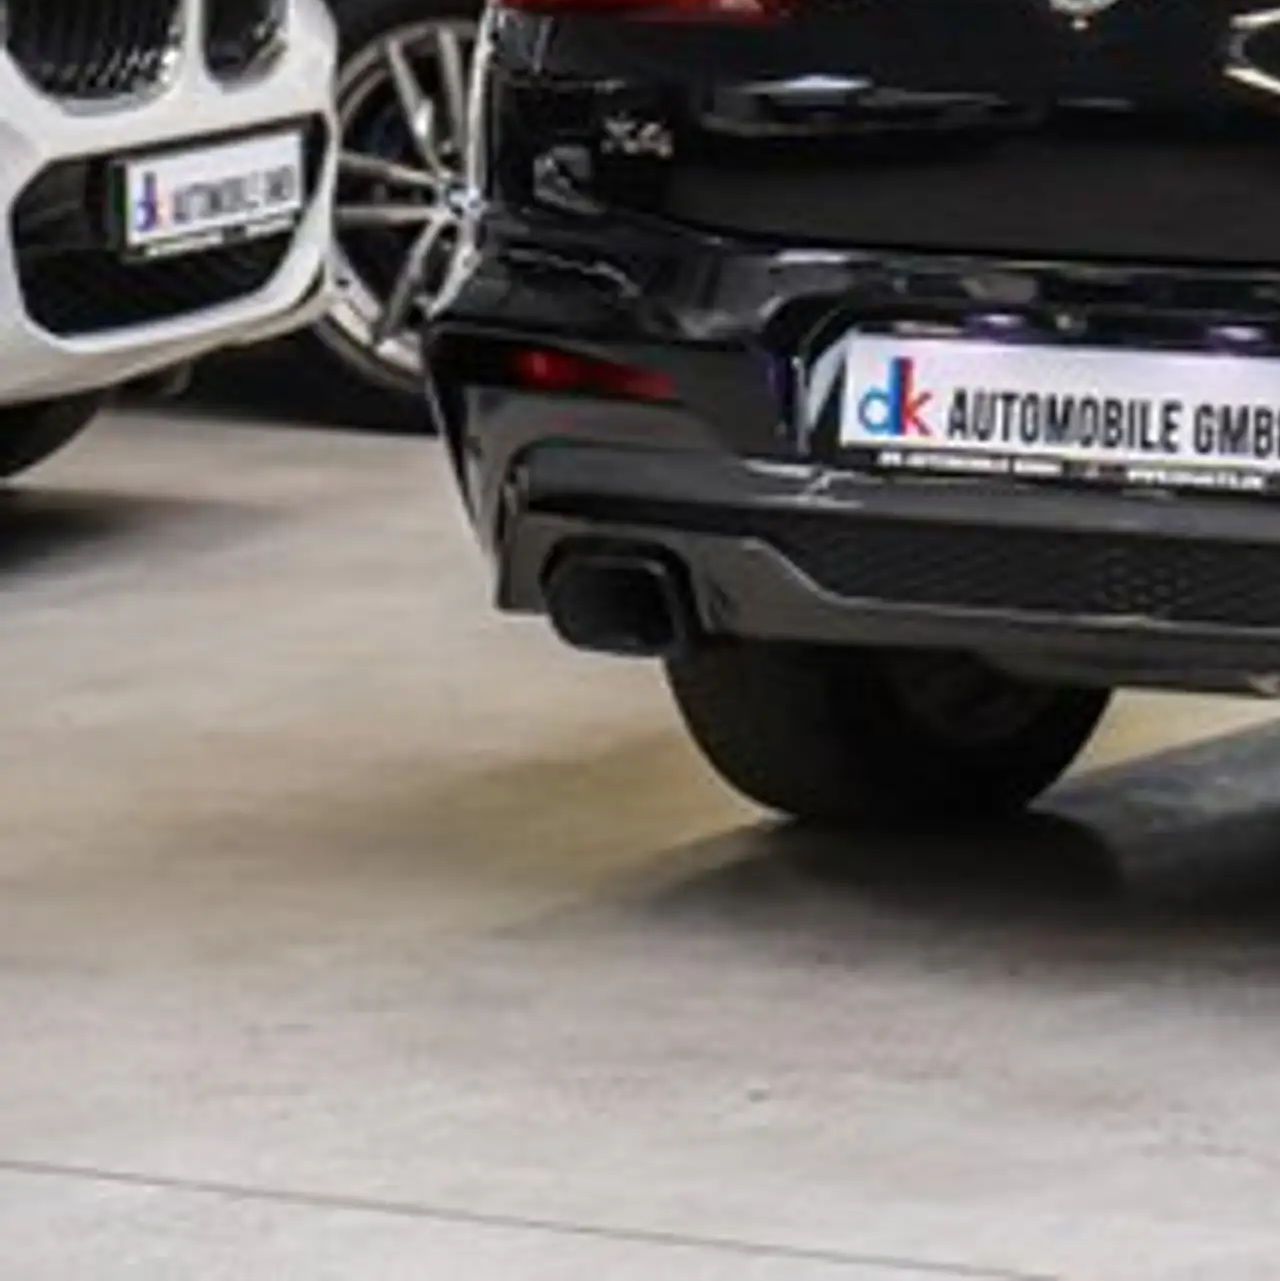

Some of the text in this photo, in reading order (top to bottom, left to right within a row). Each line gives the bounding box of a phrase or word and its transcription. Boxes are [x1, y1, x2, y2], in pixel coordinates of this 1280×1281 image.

[601, 119, 673, 156] X4
[858, 357, 932, 436] dk
[947, 388, 1183, 453] AUTOMOBILE
